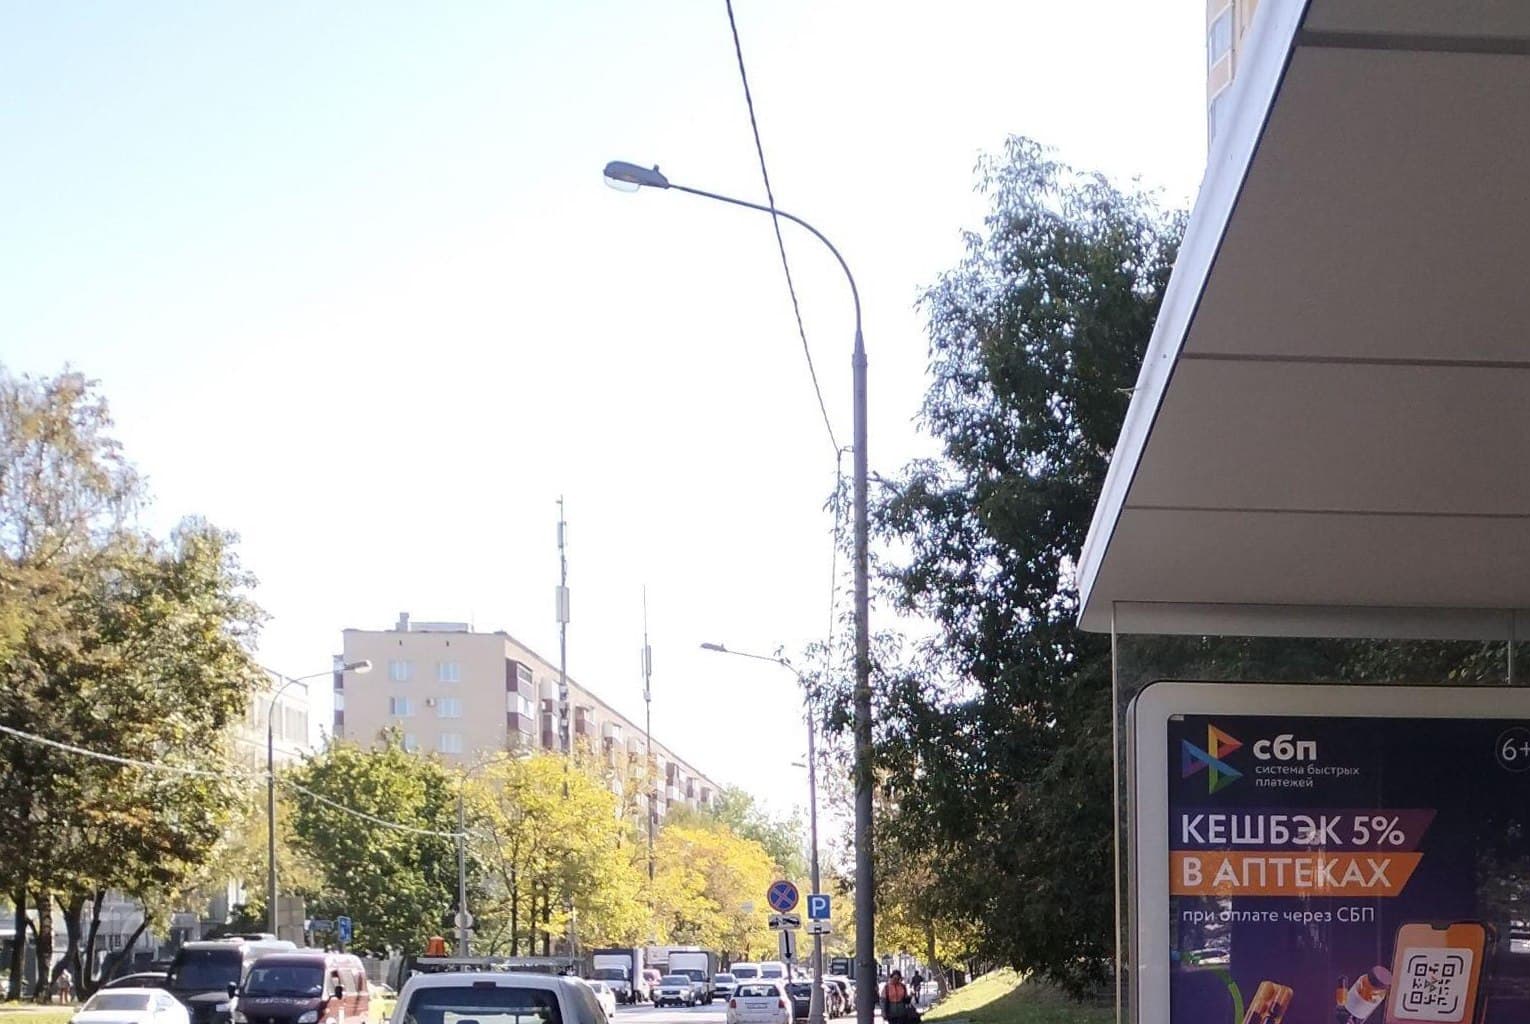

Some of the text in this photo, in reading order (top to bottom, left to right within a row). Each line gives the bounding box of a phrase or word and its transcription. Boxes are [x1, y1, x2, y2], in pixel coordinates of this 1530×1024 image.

[1252, 734, 1317, 761] сбп
[1255, 764, 1360, 777] система быстрых
[1255, 777, 1314, 788] платежей
[1182, 814, 1406, 846] КЕШБЭК 5%
[1183, 857, 1391, 888] В АПТЕКАХ
[1183, 907, 1375, 924] при оплате через СБП
